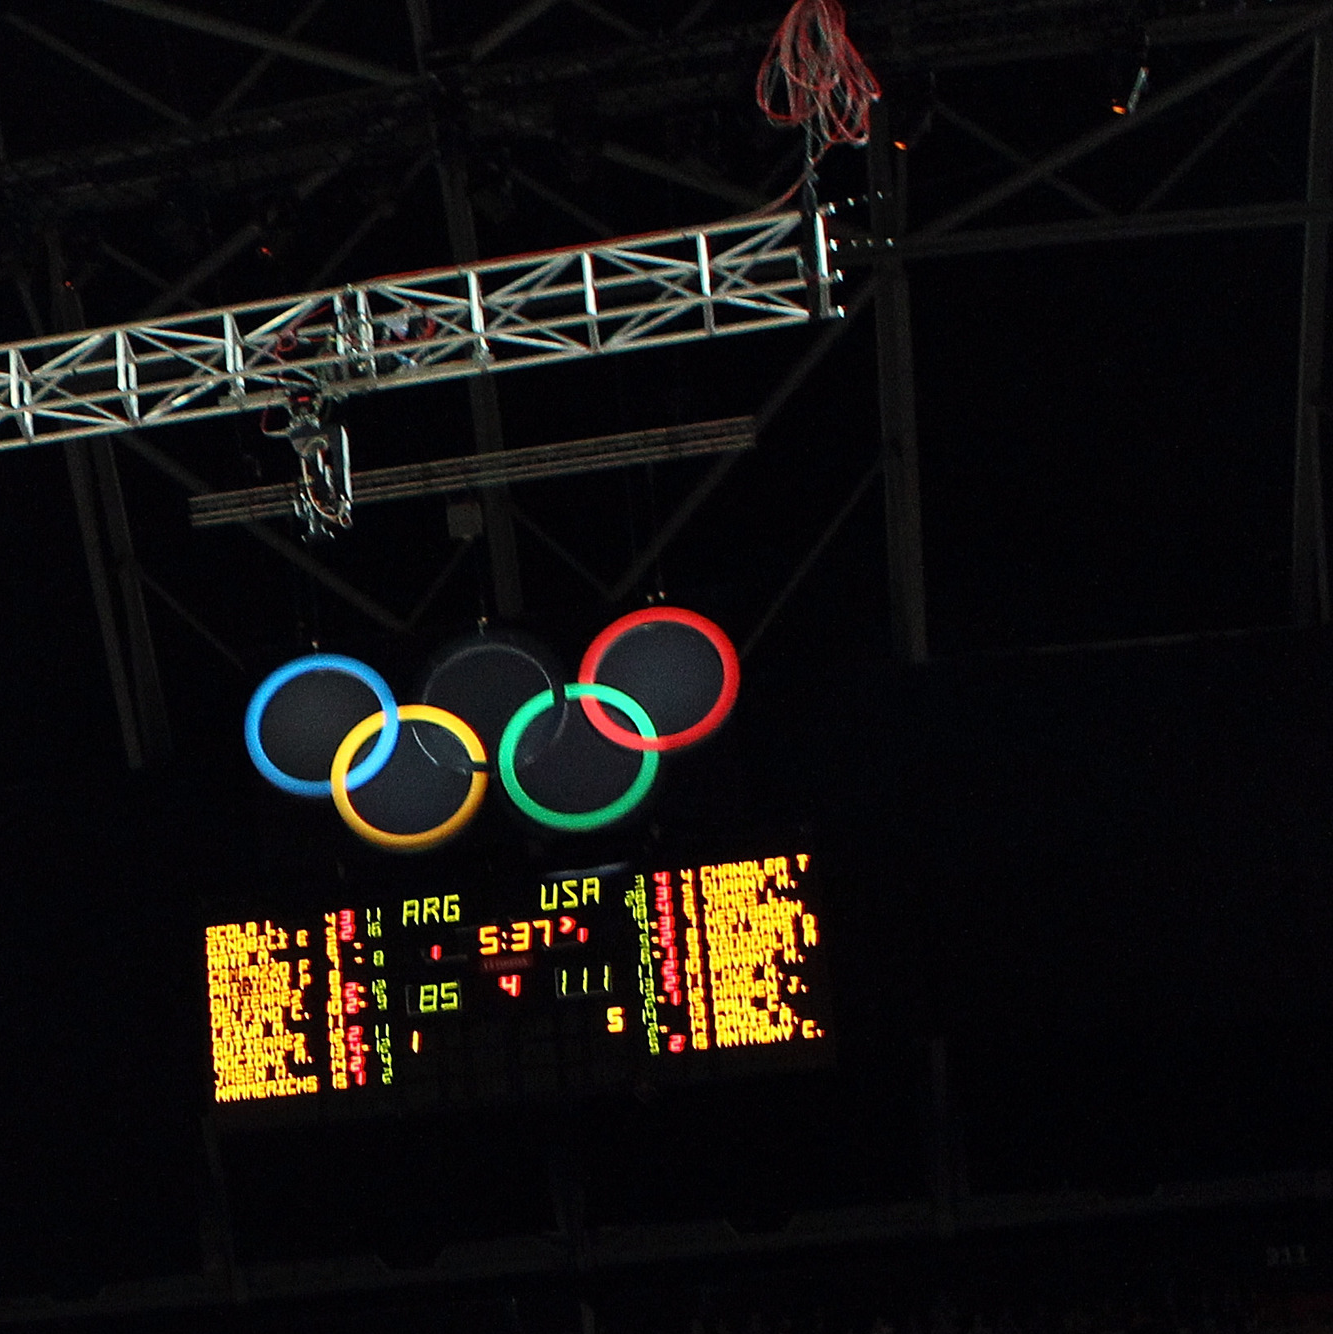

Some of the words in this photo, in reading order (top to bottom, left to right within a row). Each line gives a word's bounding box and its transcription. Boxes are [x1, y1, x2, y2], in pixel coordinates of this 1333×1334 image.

[700, 856, 788, 882] CHANDLER
[796, 853, 809, 873] T
[541, 877, 600, 912] USA
[402, 894, 461, 928] ARG
[206, 921, 258, 941] SCOLA
[479, 918, 554, 956] 5:37
[497, 974, 522, 998] 4
[562, 964, 611, 997] 111
[419, 981, 460, 1014] 85
[211, 1004, 283, 1030] DELFINO
[606, 1006, 625, 1034] 5
[410, 1029, 422, 1055] 1
